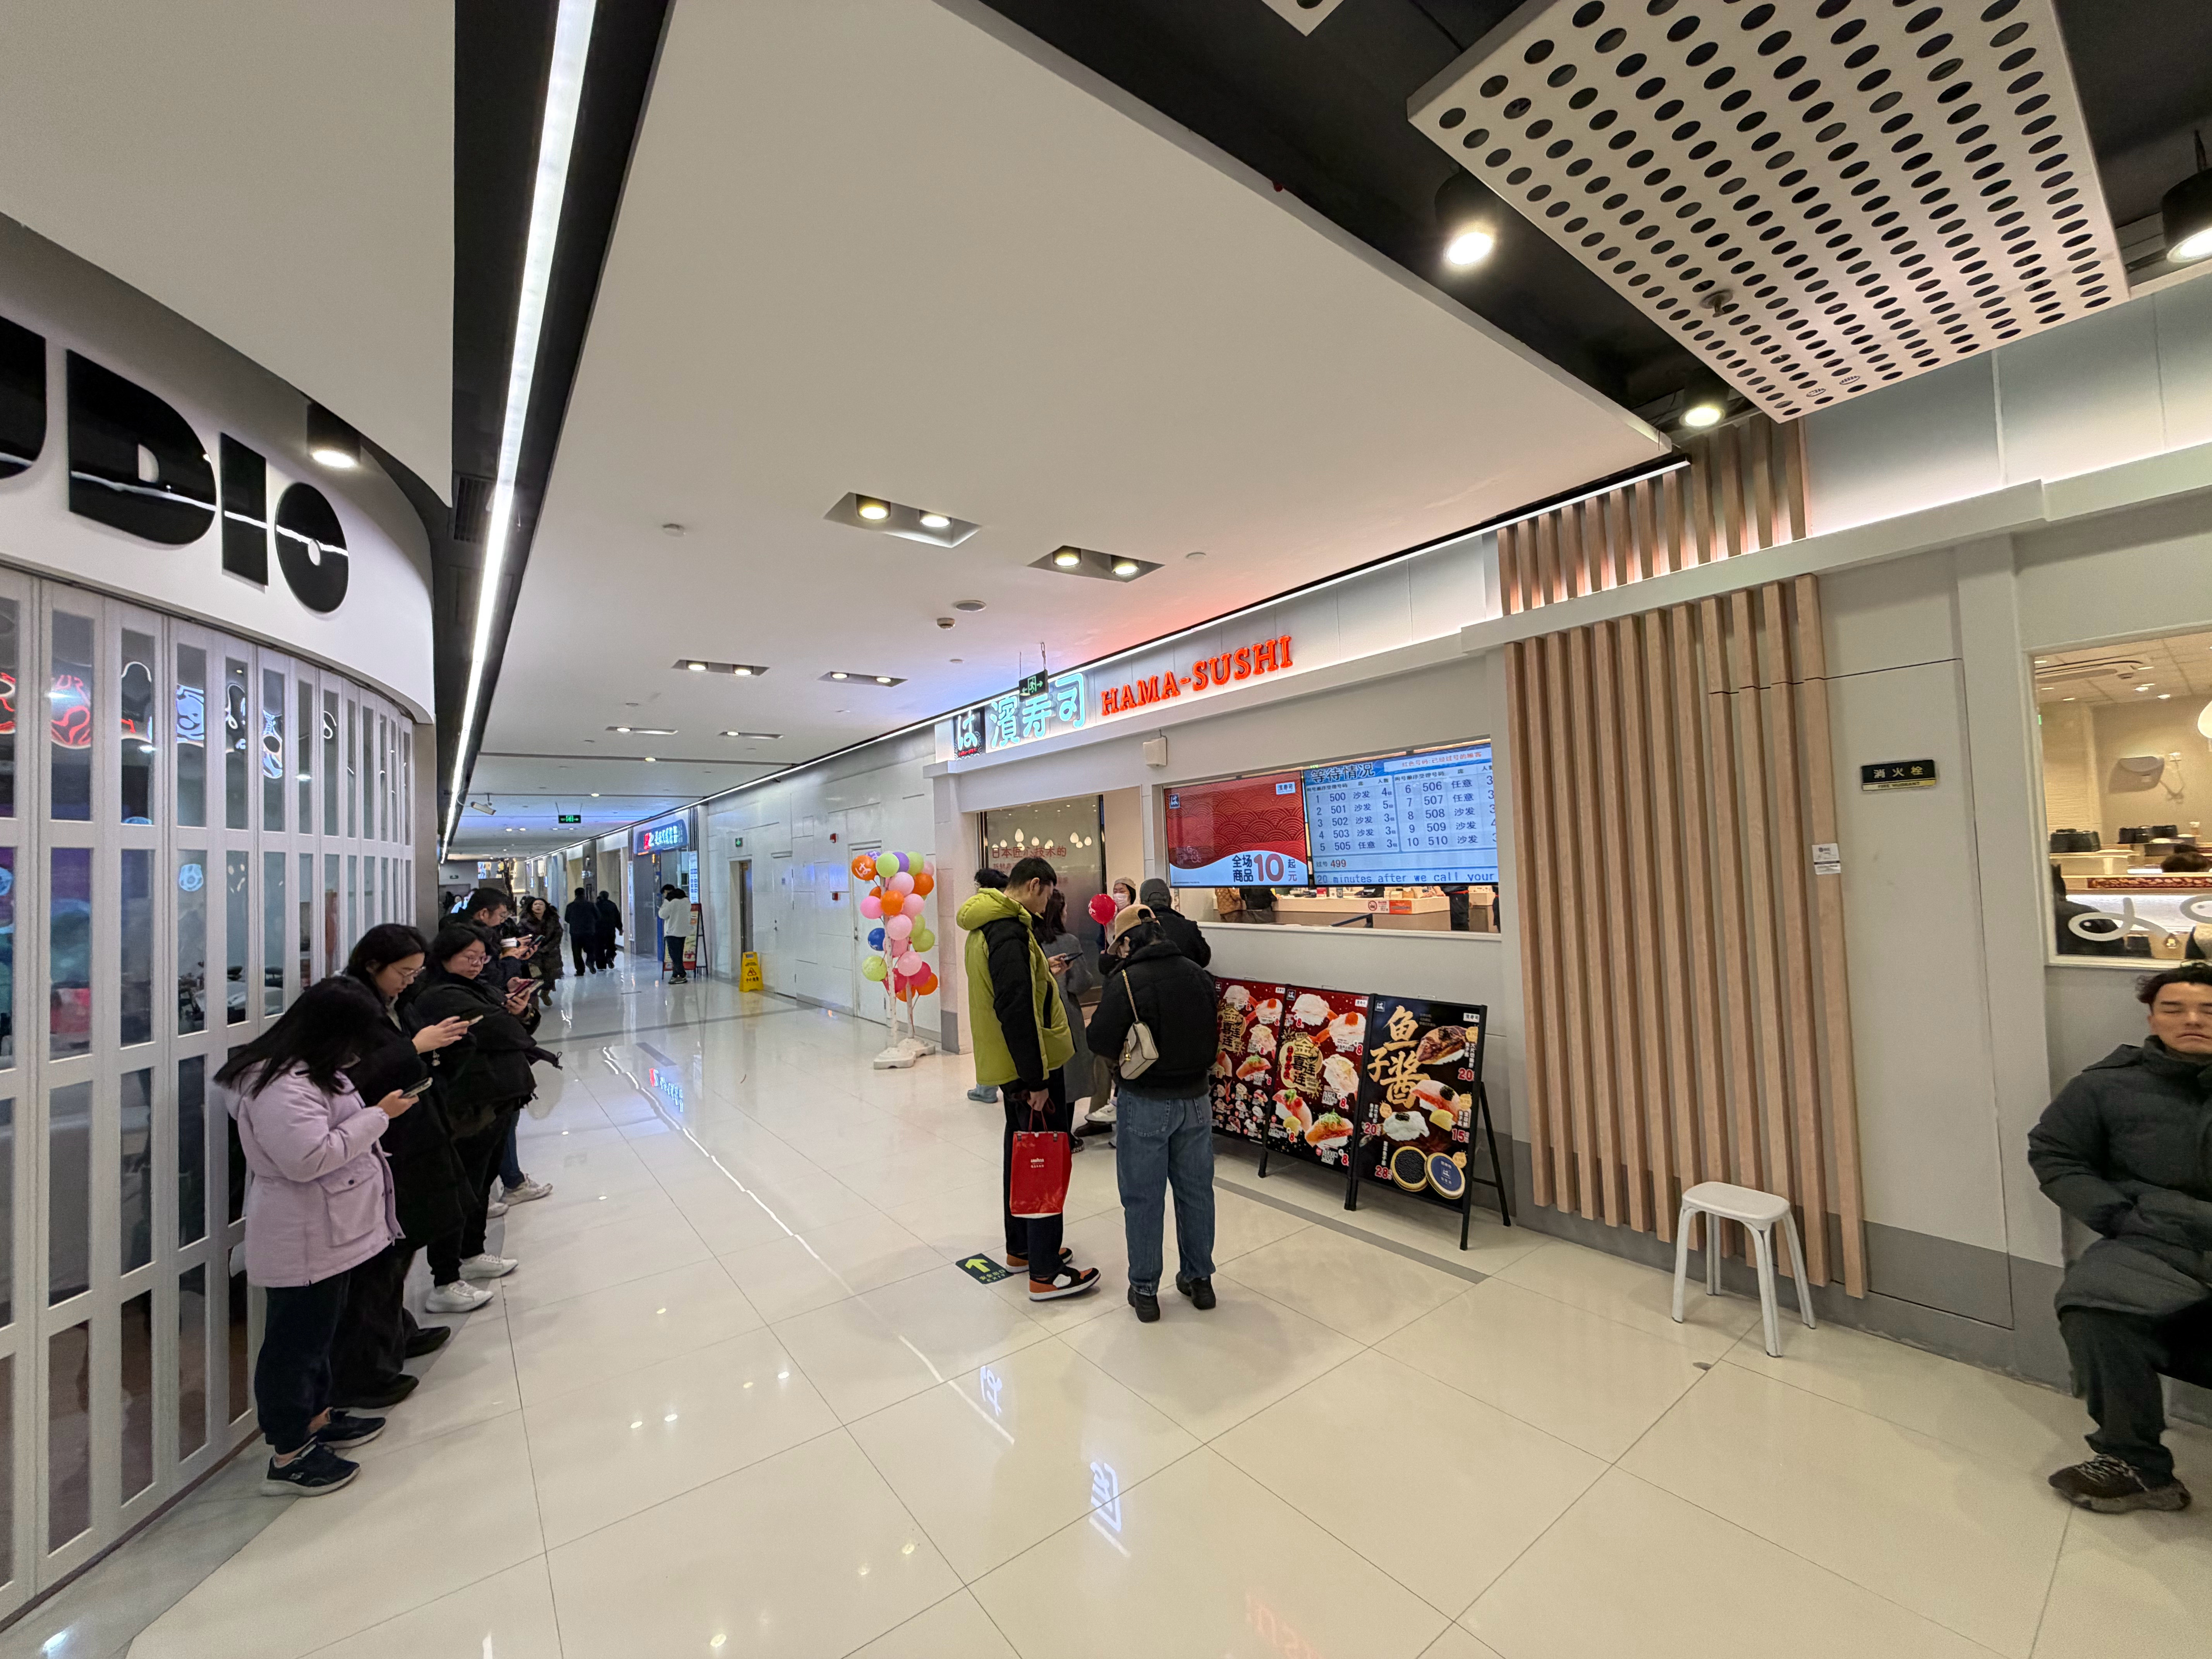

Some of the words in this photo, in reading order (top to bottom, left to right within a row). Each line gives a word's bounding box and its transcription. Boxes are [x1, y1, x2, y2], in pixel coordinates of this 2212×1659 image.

[1100, 635, 1293, 716] HAMA-SUSHI
[957, 709, 978, 750] は
[1311, 763, 1375, 783] 等待情况
[1874, 766, 1923, 778] 消火栓
[1405, 785, 1411, 793] 6
[1423, 781, 1442, 792] 506
[1451, 779, 1472, 789] 任意
[1170, 795, 1178, 807] は
[1316, 795, 1319, 803] 1
[1330, 793, 1346, 802] 500
[1353, 790, 1370, 799] 沙发
[1407, 798, 1412, 807] 7
[1424, 795, 1443, 805] 507
[1453, 793, 1474, 803] 任意
[1317, 807, 1322, 816] 2
[1331, 805, 1346, 814] 501
[1354, 803, 1371, 812] 沙发
[1408, 811, 1414, 820] 8
[1425, 809, 1445, 819] 508
[1454, 807, 1475, 816] 沙发
[1317, 819, 1323, 827] 3
[1332, 817, 1348, 826] 502
[1355, 816, 1373, 824] 沙发
[1409, 824, 1415, 833] 9
[1427, 822, 1446, 832] 509
[1456, 821, 1477, 830] 沙发
[1319, 831, 1324, 839] 4
[1333, 830, 1350, 838] 503
[1357, 828, 1374, 837] 沙发
[1320, 843, 1325, 851] 5
[1334, 842, 1350, 850] 505
[1358, 841, 1375, 849] 任意
[1407, 837, 1419, 847] 10
[1428, 836, 1448, 845] 510
[1457, 835, 1478, 844] 沙发
[1232, 855, 1252, 868] 全场
[1254, 853, 1284, 882] 10
[1288, 859, 1296, 869] 起
[1330, 859, 1346, 868] 499
[855, 862, 872, 878] は
[1233, 869, 1254, 883] 商品
[1288, 871, 1297, 881] 元
[1317, 875, 1328, 884] 20
[1333, 874, 1372, 883] minutes
[1378, 873, 1407, 883] after
[1434, 872, 1458, 881] call
[1466, 873, 1495, 881] your
[1357, 1043, 1363, 1055] 8
[1367, 1005, 1431, 1109] 鱼子酱
[1458, 1068, 1473, 1081] 20
[1340, 1097, 1347, 1108] 8
[1364, 1122, 1377, 1135] 20
[1452, 1128, 1465, 1142] 15
[1289, 1132, 1295, 1142] 8
[1342, 1154, 1348, 1164] 8
[1375, 1165, 1389, 1179] 28
